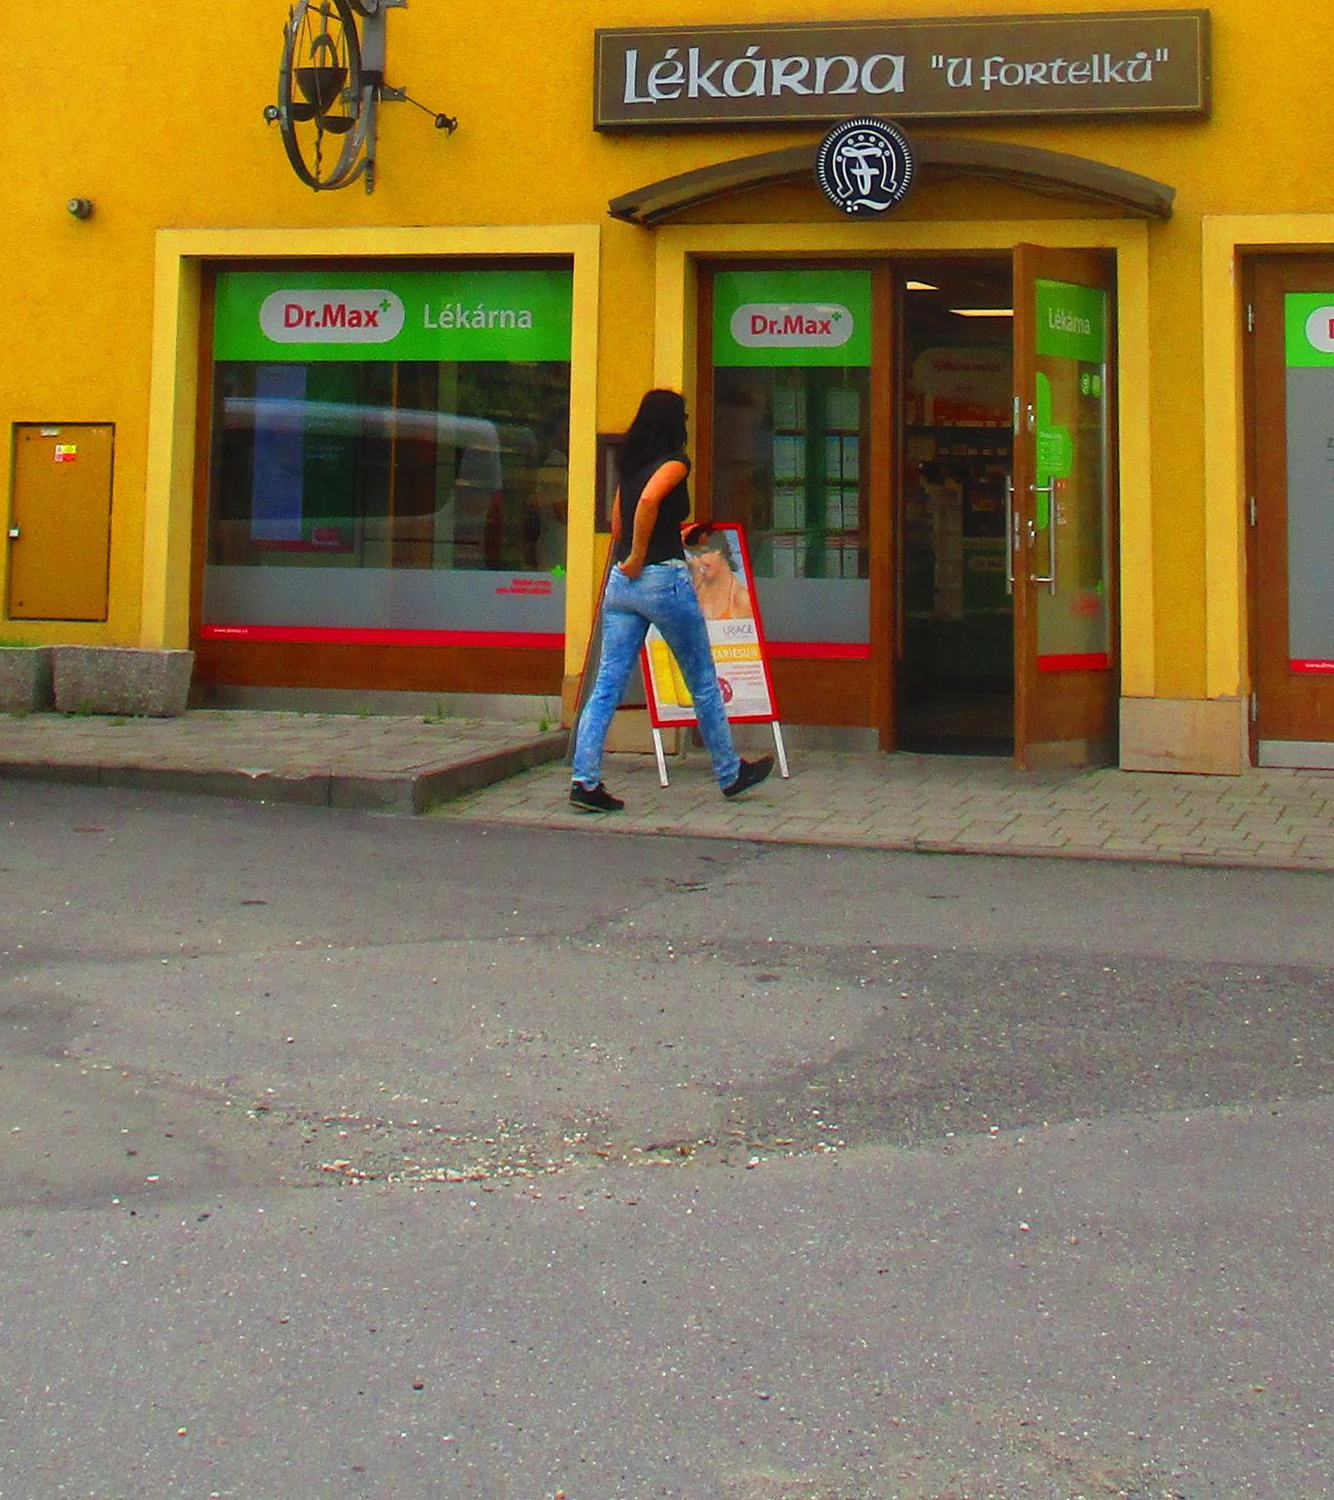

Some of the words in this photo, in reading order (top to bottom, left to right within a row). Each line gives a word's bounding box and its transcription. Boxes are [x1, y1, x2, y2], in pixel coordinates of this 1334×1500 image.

[623, 45, 906, 105] Lékárna
[283, 303, 380, 329] Dr.Max
[423, 302, 533, 329] Lékárna
[750, 314, 832, 335] Dr.Max
